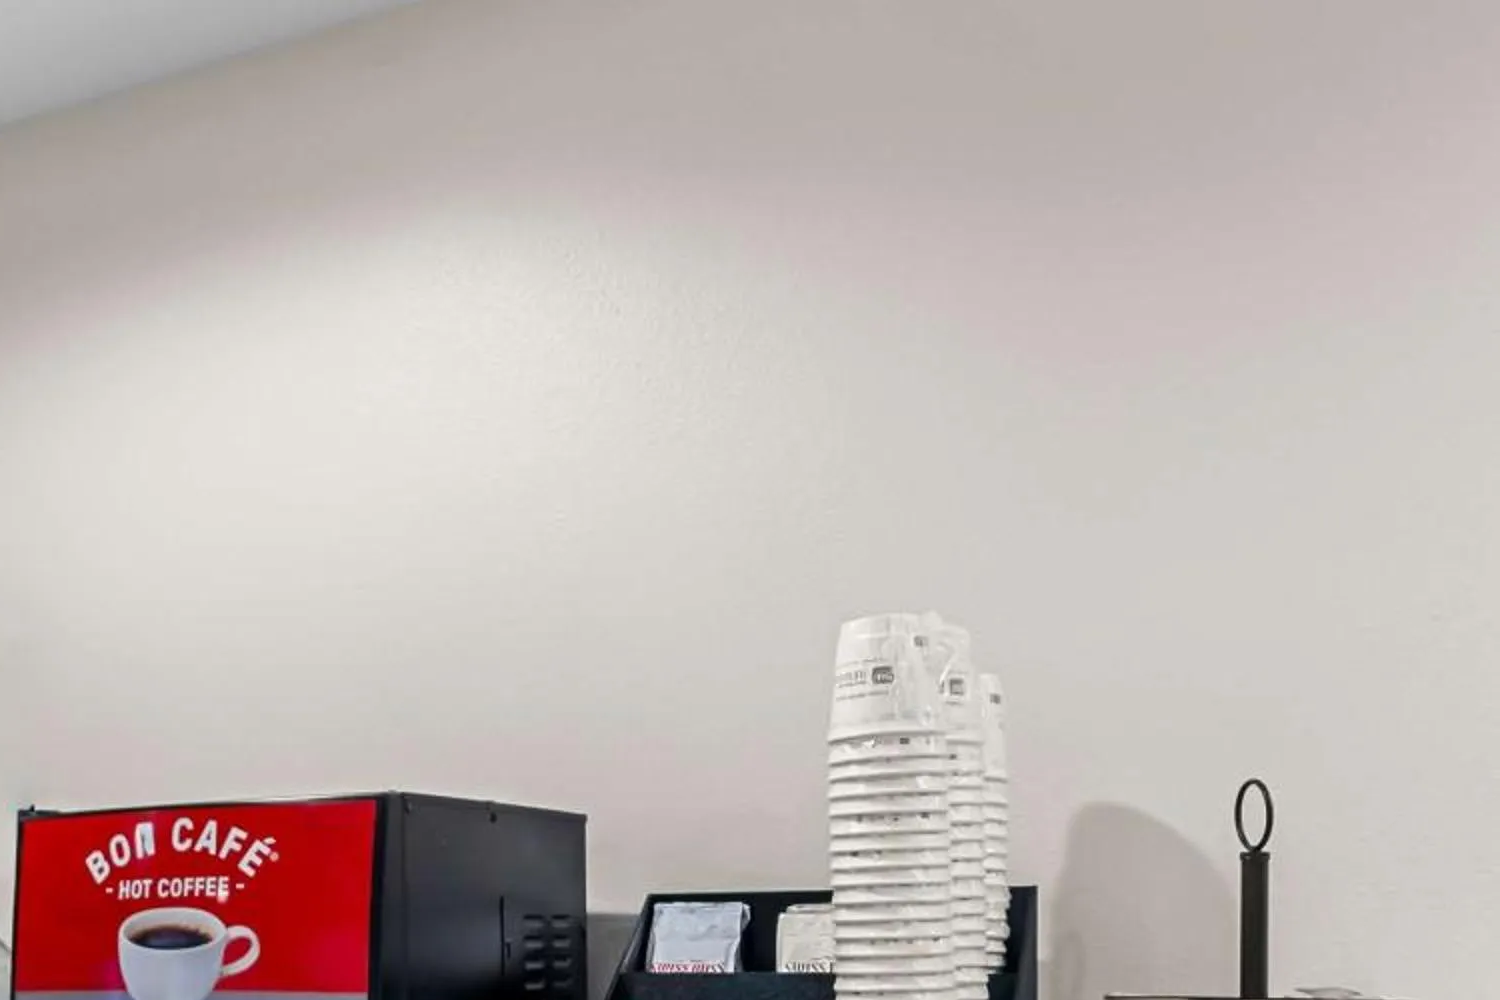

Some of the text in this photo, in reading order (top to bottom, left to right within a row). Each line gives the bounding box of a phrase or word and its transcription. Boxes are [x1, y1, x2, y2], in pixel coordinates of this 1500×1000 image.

[85, 821, 156, 885] BON
[118, 875, 229, 900] HOT COFFEE
